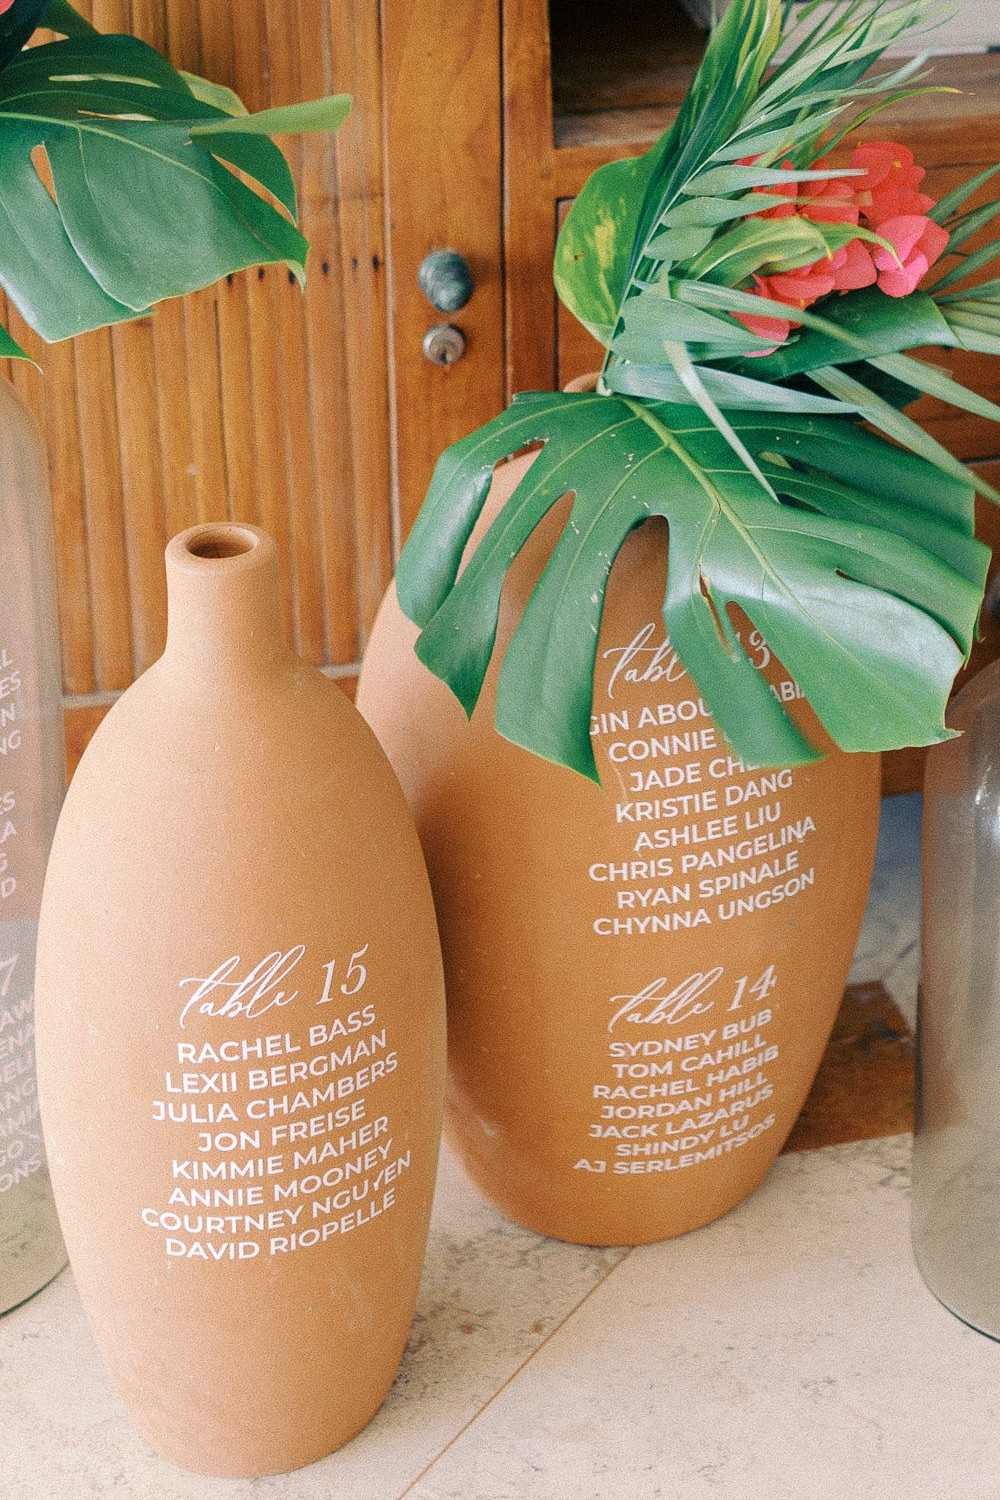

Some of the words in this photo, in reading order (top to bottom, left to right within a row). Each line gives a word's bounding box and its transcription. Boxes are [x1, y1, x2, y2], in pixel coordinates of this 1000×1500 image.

[608, 727, 717, 763] CONNIE
[614, 790, 718, 824] KRISTIE
[725, 768, 794, 807] DANG
[629, 763, 702, 793] JADE
[588, 857, 674, 883] CHRIS
[681, 815, 817, 874] PANGELINA
[633, 814, 738, 852] ASHLEE
[745, 801, 781, 831] LIU
[592, 909, 712, 937] CHYNNA
[717, 867, 816, 922] UNGSON
[616, 884, 691, 911] RYAN
[698, 850, 801, 901] SPINALE
[315, 943, 370, 1006] 15
[727, 964, 778, 1012] 14
[165, 1071, 237, 1094] LEXII
[248, 1029, 387, 1091] BERGMAN
[177, 1033, 300, 1064] RACHEL
[309, 1004, 376, 1047] BASS
[608, 1029, 716, 1058] SYDNEY
[722, 1009, 773, 1041] BUB
[611, 1061, 673, 1079] TOM
[680, 1034, 767, 1073] CAHILL
[152, 1100, 239, 1124] JULIA
[247, 1051, 398, 1120] CHAMBERS
[592, 1078, 700, 1100] RACHEL
[706, 1045, 779, 1087] HABIB
[600, 1093, 712, 1120] JORDAN
[718, 1072, 768, 1103] HILL
[198, 1129, 261, 1152] JON
[271, 1098, 367, 1146] FREISE
[589, 1123, 659, 1139] JACK
[665, 1084, 774, 1135] LAZARUS
[615, 1130, 713, 1157] SHINDY
[719, 1115, 750, 1137] LU
[172, 1155, 284, 1181] KIMMIE
[294, 1115, 389, 1170] MAHER
[573, 1158, 606, 1173] AJ
[612, 1113, 776, 1175] SERLEMITSOS
[141, 1205, 304, 1235] COURTNEY
[311, 1149, 412, 1219] NGUYEN
[168, 1186, 264, 1208] ANNIE
[273, 1139, 393, 1202] MOONEY
[165, 1238, 260, 1261] DAVID
[269, 1187, 396, 1256] RIOPELLE
